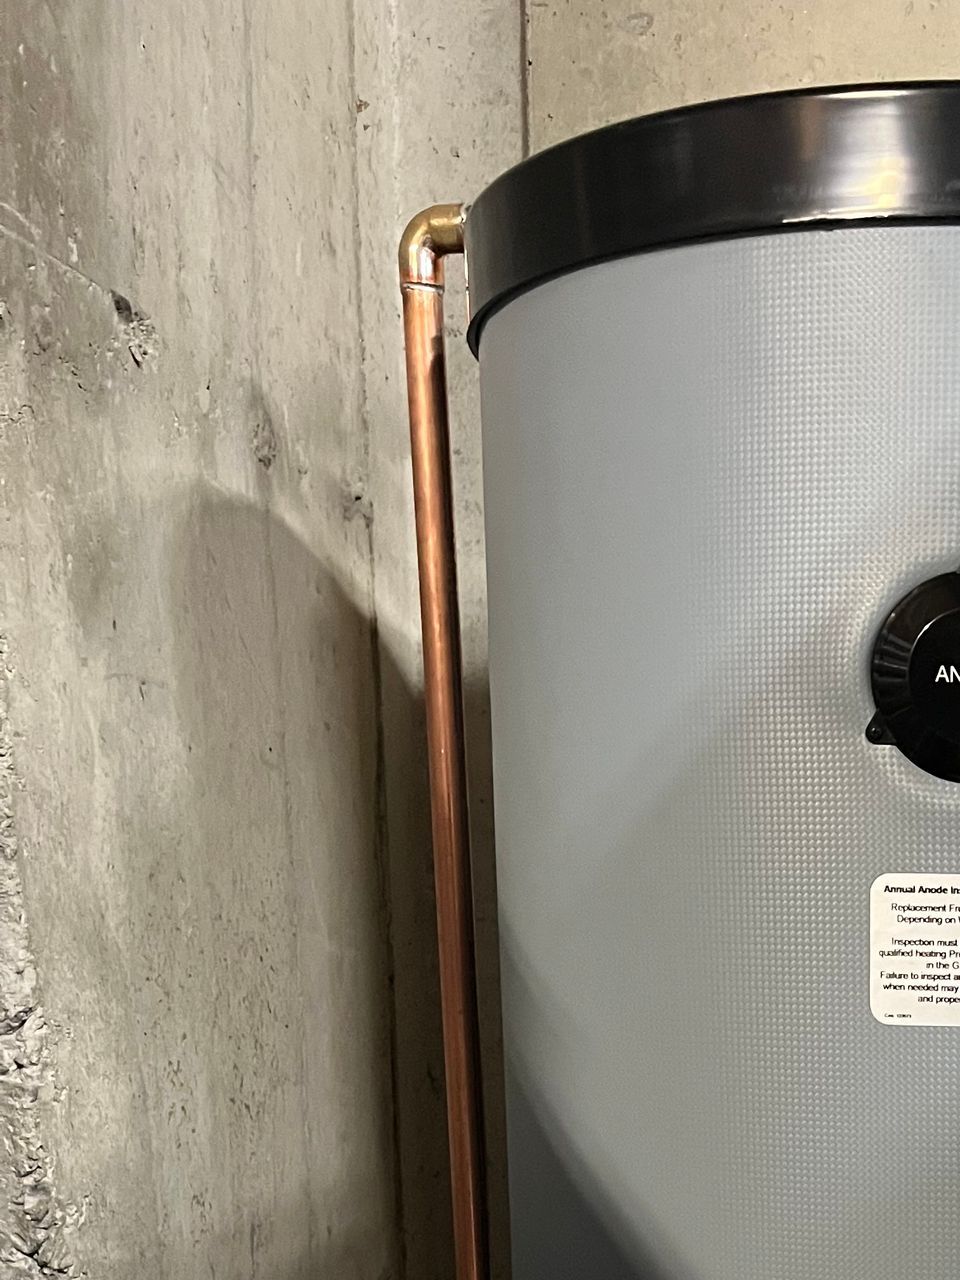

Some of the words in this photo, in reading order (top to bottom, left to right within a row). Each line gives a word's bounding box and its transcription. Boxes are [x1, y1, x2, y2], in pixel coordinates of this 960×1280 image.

[884, 885, 915, 893] Annual
[918, 886, 948, 894] Anode
[891, 903, 946, 913] Replacement
[897, 914, 943, 925] Depending
[892, 937, 935, 947] Inspection
[879, 949, 913, 958] qualified
[916, 950, 947, 959] heating
[936, 961, 949, 969] the
[880, 971, 909, 979] Failure
[911, 972, 919, 980] to
[921, 973, 951, 981] inspect
[941, 985, 959, 993] may
